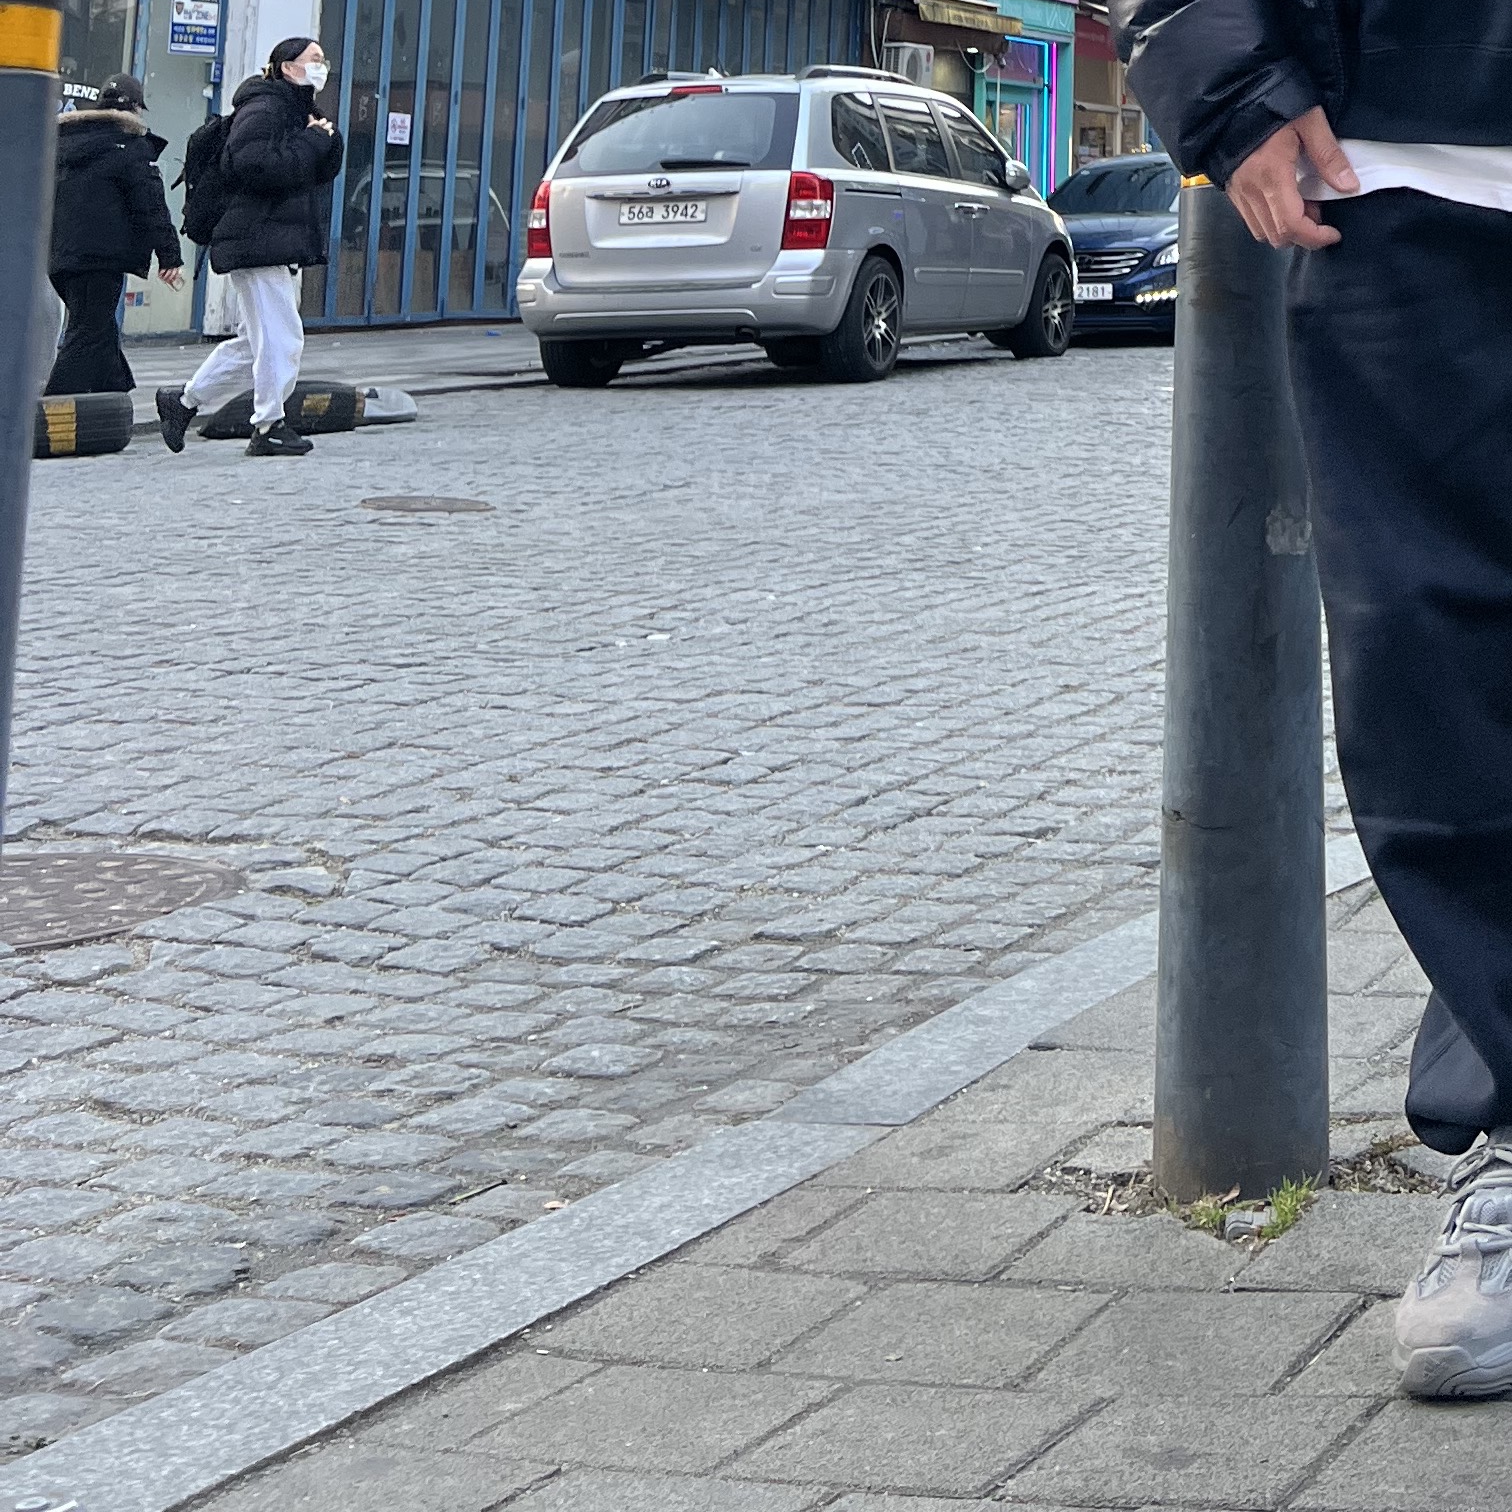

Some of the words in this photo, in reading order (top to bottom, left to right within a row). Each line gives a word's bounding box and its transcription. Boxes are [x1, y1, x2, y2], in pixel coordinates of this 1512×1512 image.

[63, 83, 100, 101] BENE
[661, 203, 699, 220] 3942
[1077, 285, 1105, 298] 2181
